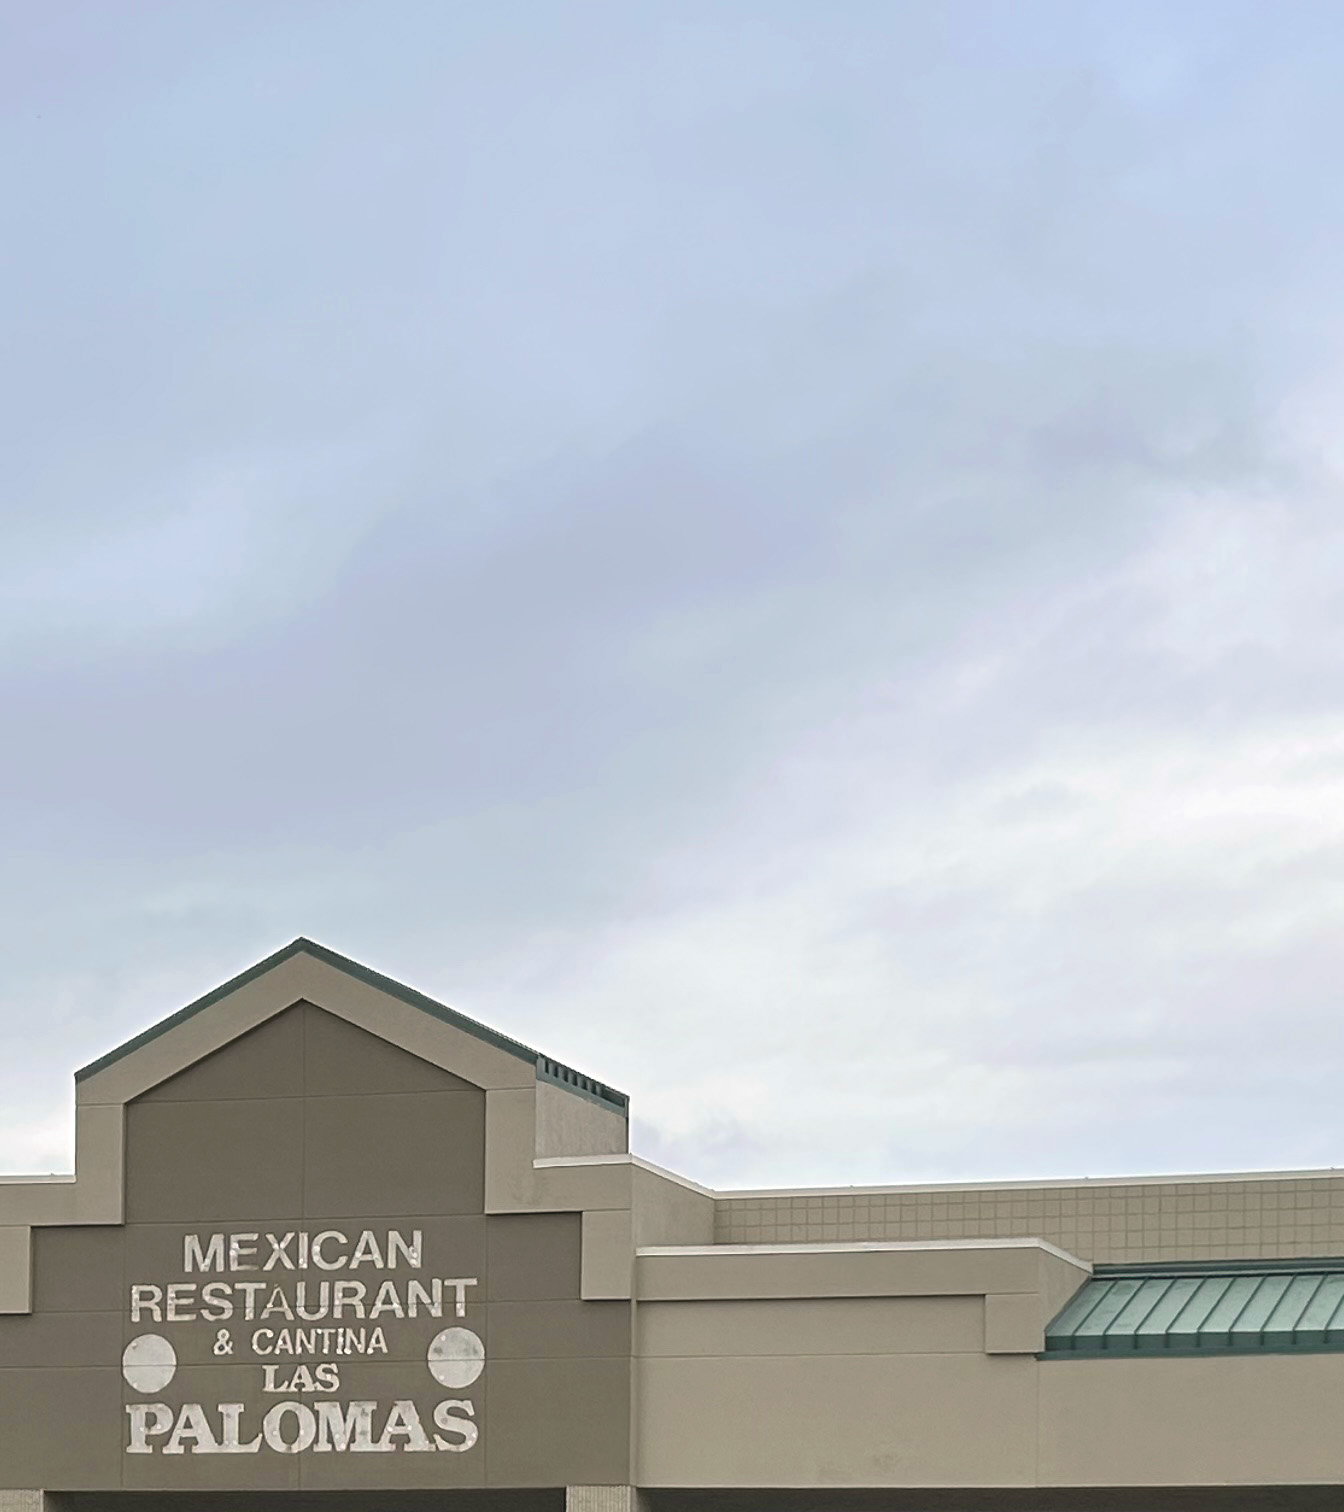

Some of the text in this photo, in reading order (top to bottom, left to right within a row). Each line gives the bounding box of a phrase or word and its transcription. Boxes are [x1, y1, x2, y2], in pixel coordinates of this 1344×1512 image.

[183, 1230, 423, 1273] MEXICAN
[130, 1277, 478, 1323] RESTAURANT
[212, 1326, 389, 1355] & CANTINA
[261, 1362, 340, 1394] LAS
[125, 1398, 480, 1455] PALOMAS
